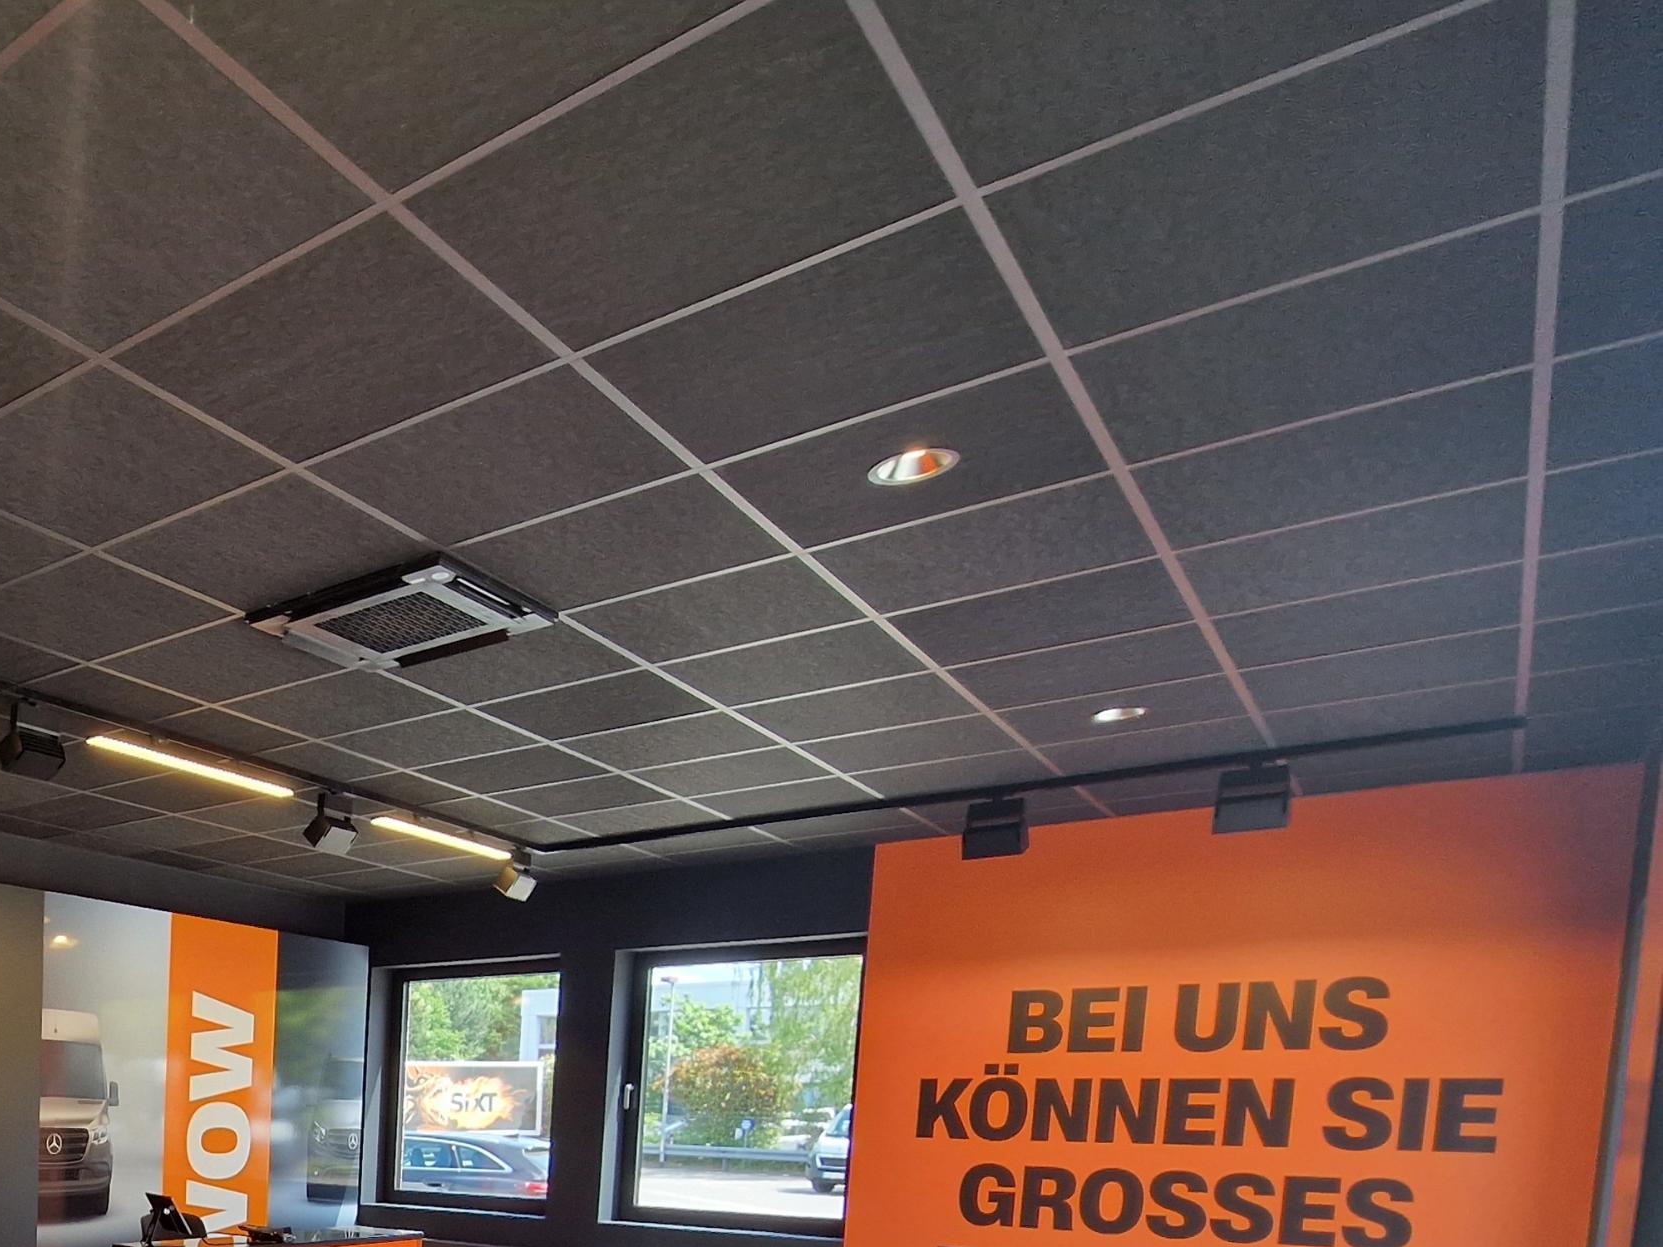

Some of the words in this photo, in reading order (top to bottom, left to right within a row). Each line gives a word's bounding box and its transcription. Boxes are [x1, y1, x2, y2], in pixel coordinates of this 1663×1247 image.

[1006, 984, 1149, 1055] BEI
[1173, 976, 1391, 1052] UNS
[914, 1063, 1296, 1148] KÖNNEN
[1321, 1077, 1505, 1154] SIE
